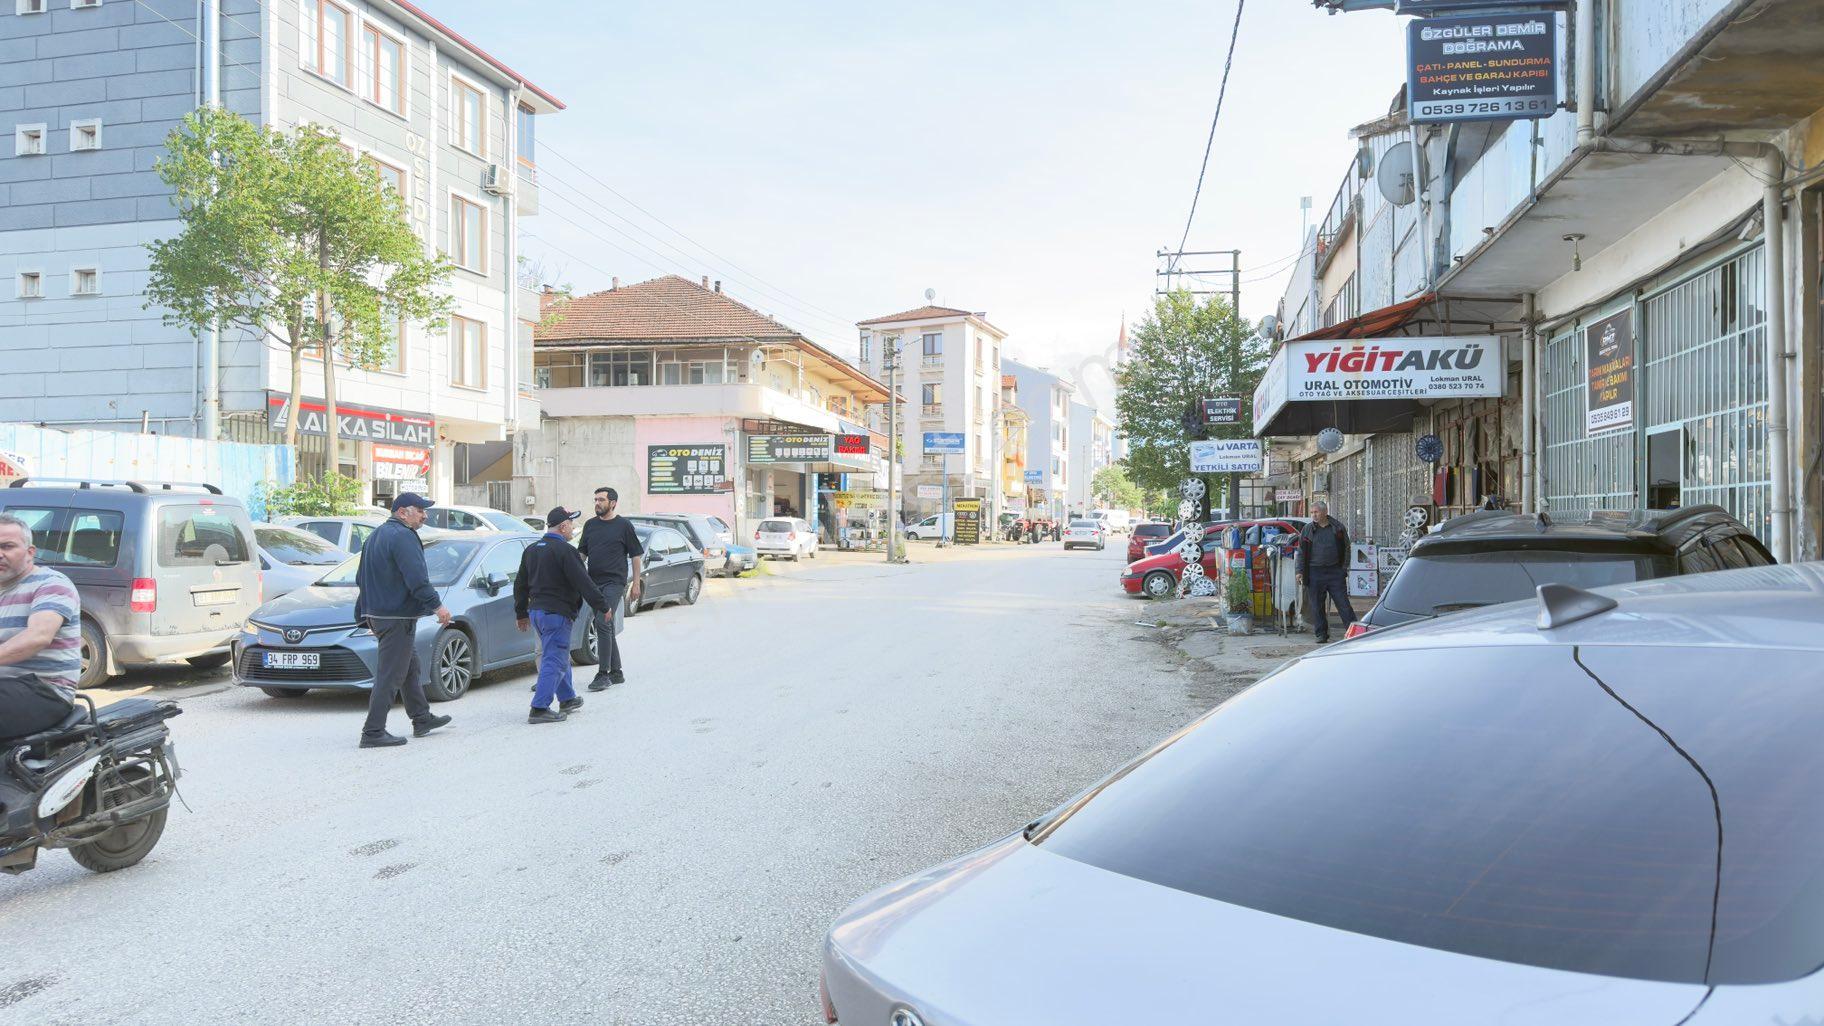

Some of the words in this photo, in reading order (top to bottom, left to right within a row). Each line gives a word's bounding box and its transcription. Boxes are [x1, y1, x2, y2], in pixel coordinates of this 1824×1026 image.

[1421, 24, 1493, 40] ÖZGÜLER
[1496, 20, 1546, 36] DEMİR
[1442, 39, 1525, 55] DOĞRAMA
[1447, 60, 1482, 70] PANEL
[1488, 57, 1550, 68] SUNDURMA
[1420, 74, 1457, 84] BAHÇE
[1474, 72, 1512, 80] GARAJ
[1513, 70, 1548, 78] KAPISI
[1433, 86, 1472, 96] Kaynak
[1474, 85, 1500, 95] İşleri
[1502, 83, 1536, 93] Yapılır
[1422, 104, 1465, 116] 0539
[1468, 102, 1500, 113] 726
[1505, 101, 1524, 111] 13
[1528, 100, 1548, 110] 61
[1305, 379, 1340, 391] URAL
[1344, 378, 1413, 390] OTOMOTİV
[304, 412, 368, 437] AKA
[372, 413, 431, 444] SİLAH
[691, 447, 723, 456] DENİZ
[1226, 443, 1259, 451] VARTA
[1231, 463, 1260, 472] SATICI
[269, 654, 278, 664] 34
[282, 654, 298, 664] FRP
[302, 654, 318, 664] 969
